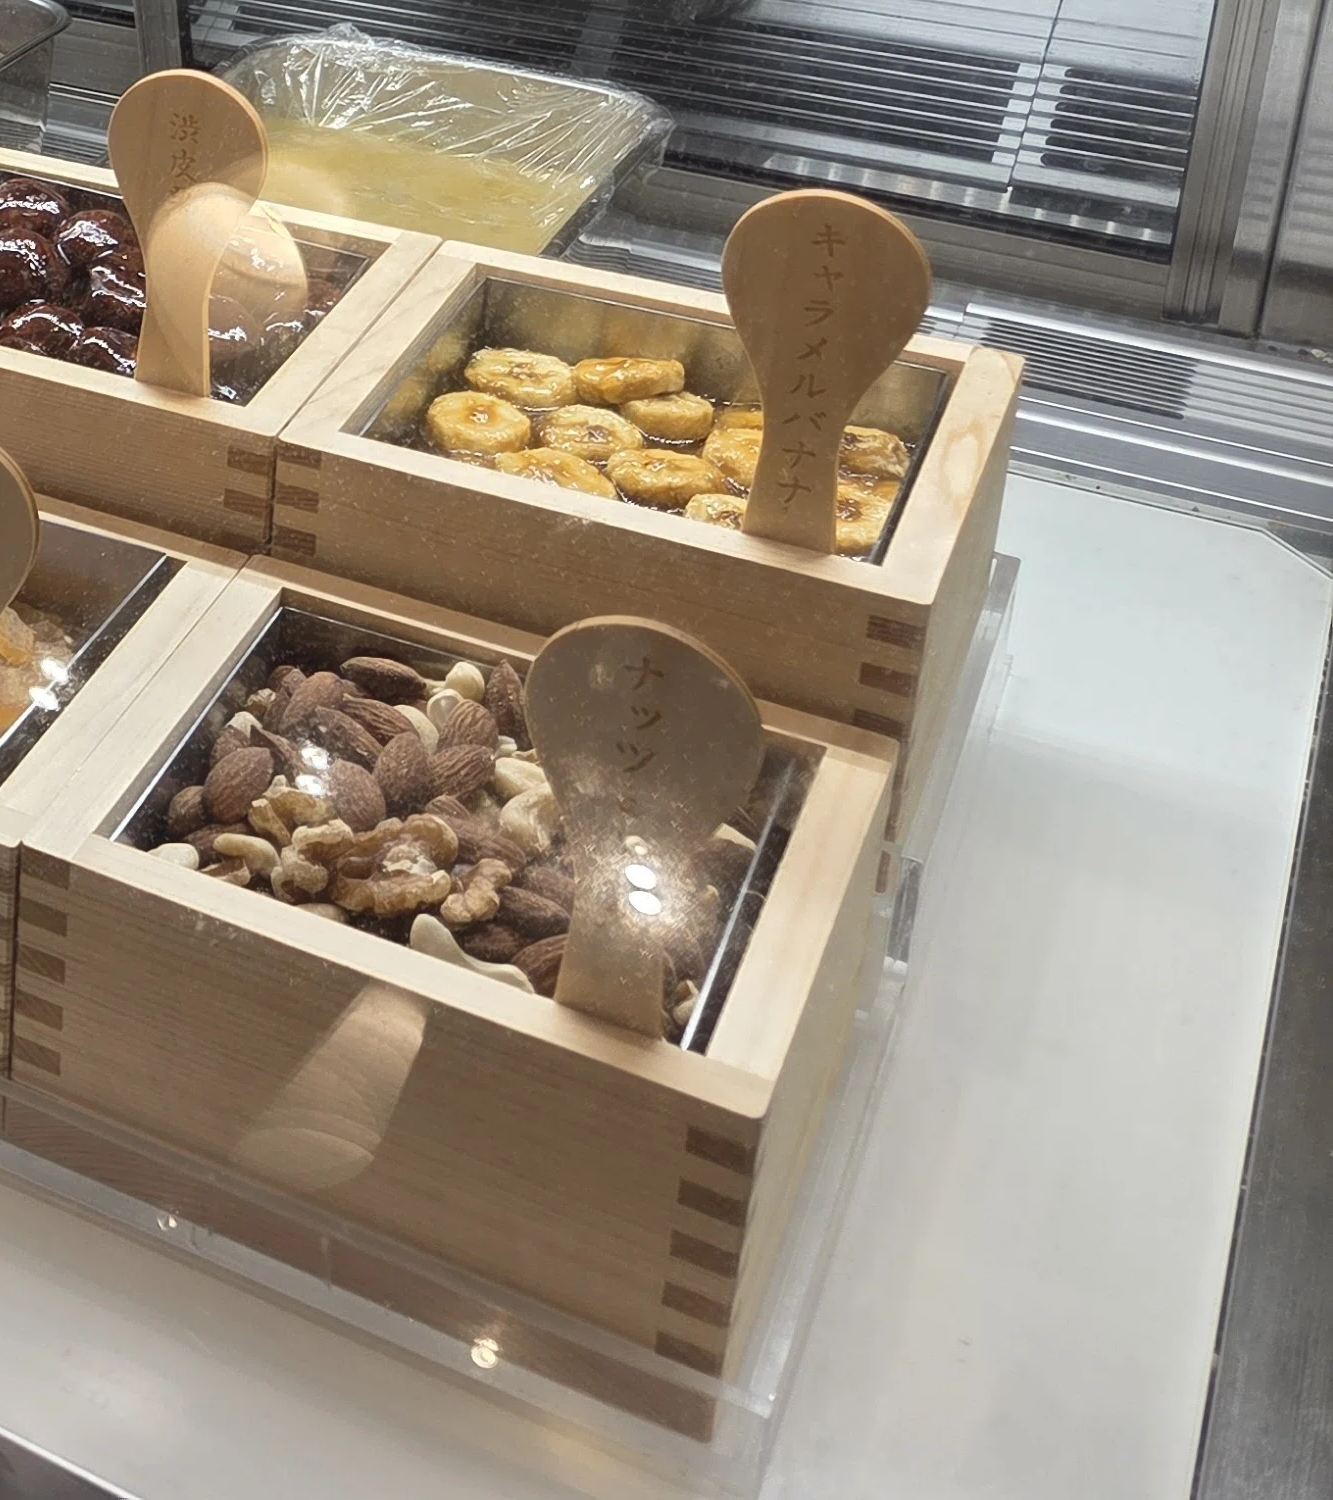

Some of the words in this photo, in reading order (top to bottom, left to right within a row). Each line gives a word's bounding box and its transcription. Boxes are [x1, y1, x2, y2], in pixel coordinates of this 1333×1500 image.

[168, 111, 202, 197] 渋皮
[777, 222, 846, 506] キャラメルバナナ
[614, 655, 665, 774] ナッツ
